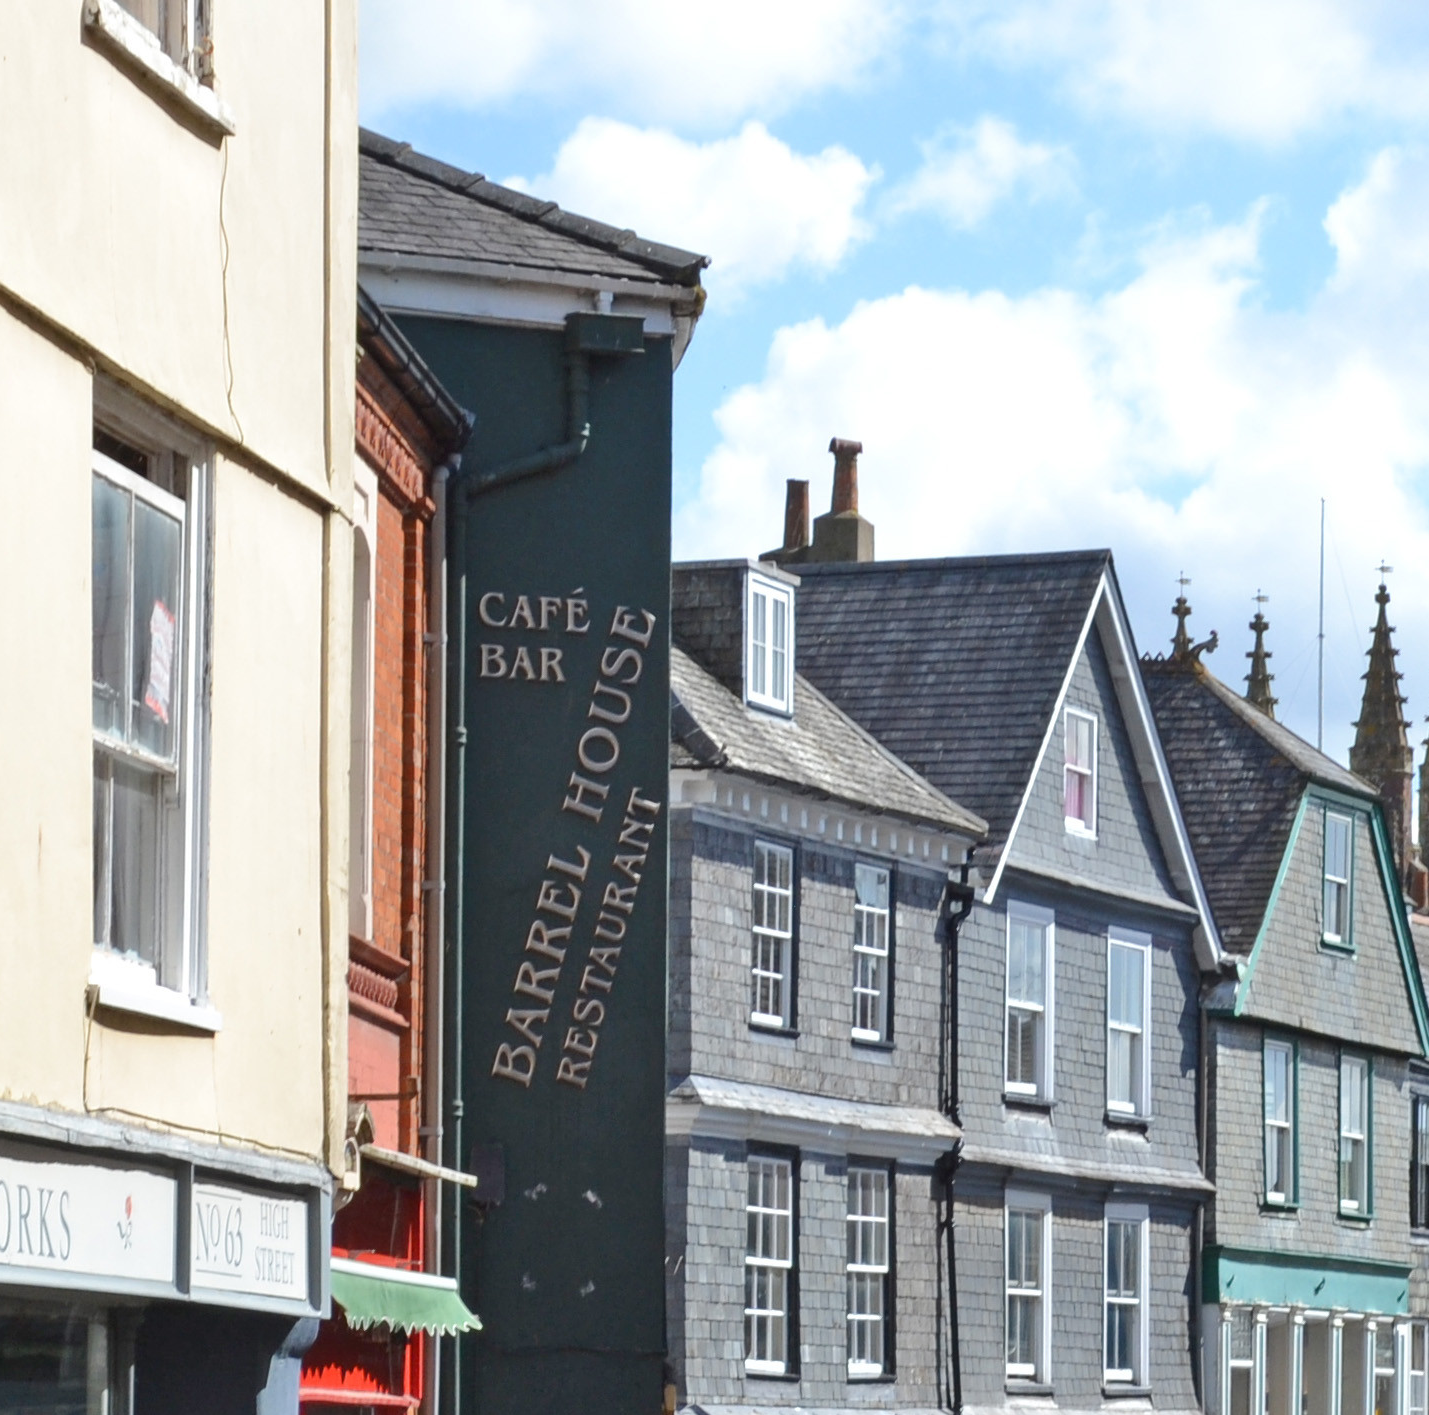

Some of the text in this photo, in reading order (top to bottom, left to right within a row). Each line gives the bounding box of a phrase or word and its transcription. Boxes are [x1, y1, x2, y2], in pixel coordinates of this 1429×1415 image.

[479, 587, 590, 634] CAFÉ
[479, 644, 566, 682] BAR
[491, 605, 656, 1088] BARREL HOUSE
[556, 787, 662, 1090] RESTAURANT
[259, 1201, 290, 1240] HIGH
[254, 1245, 295, 1285] STREET
